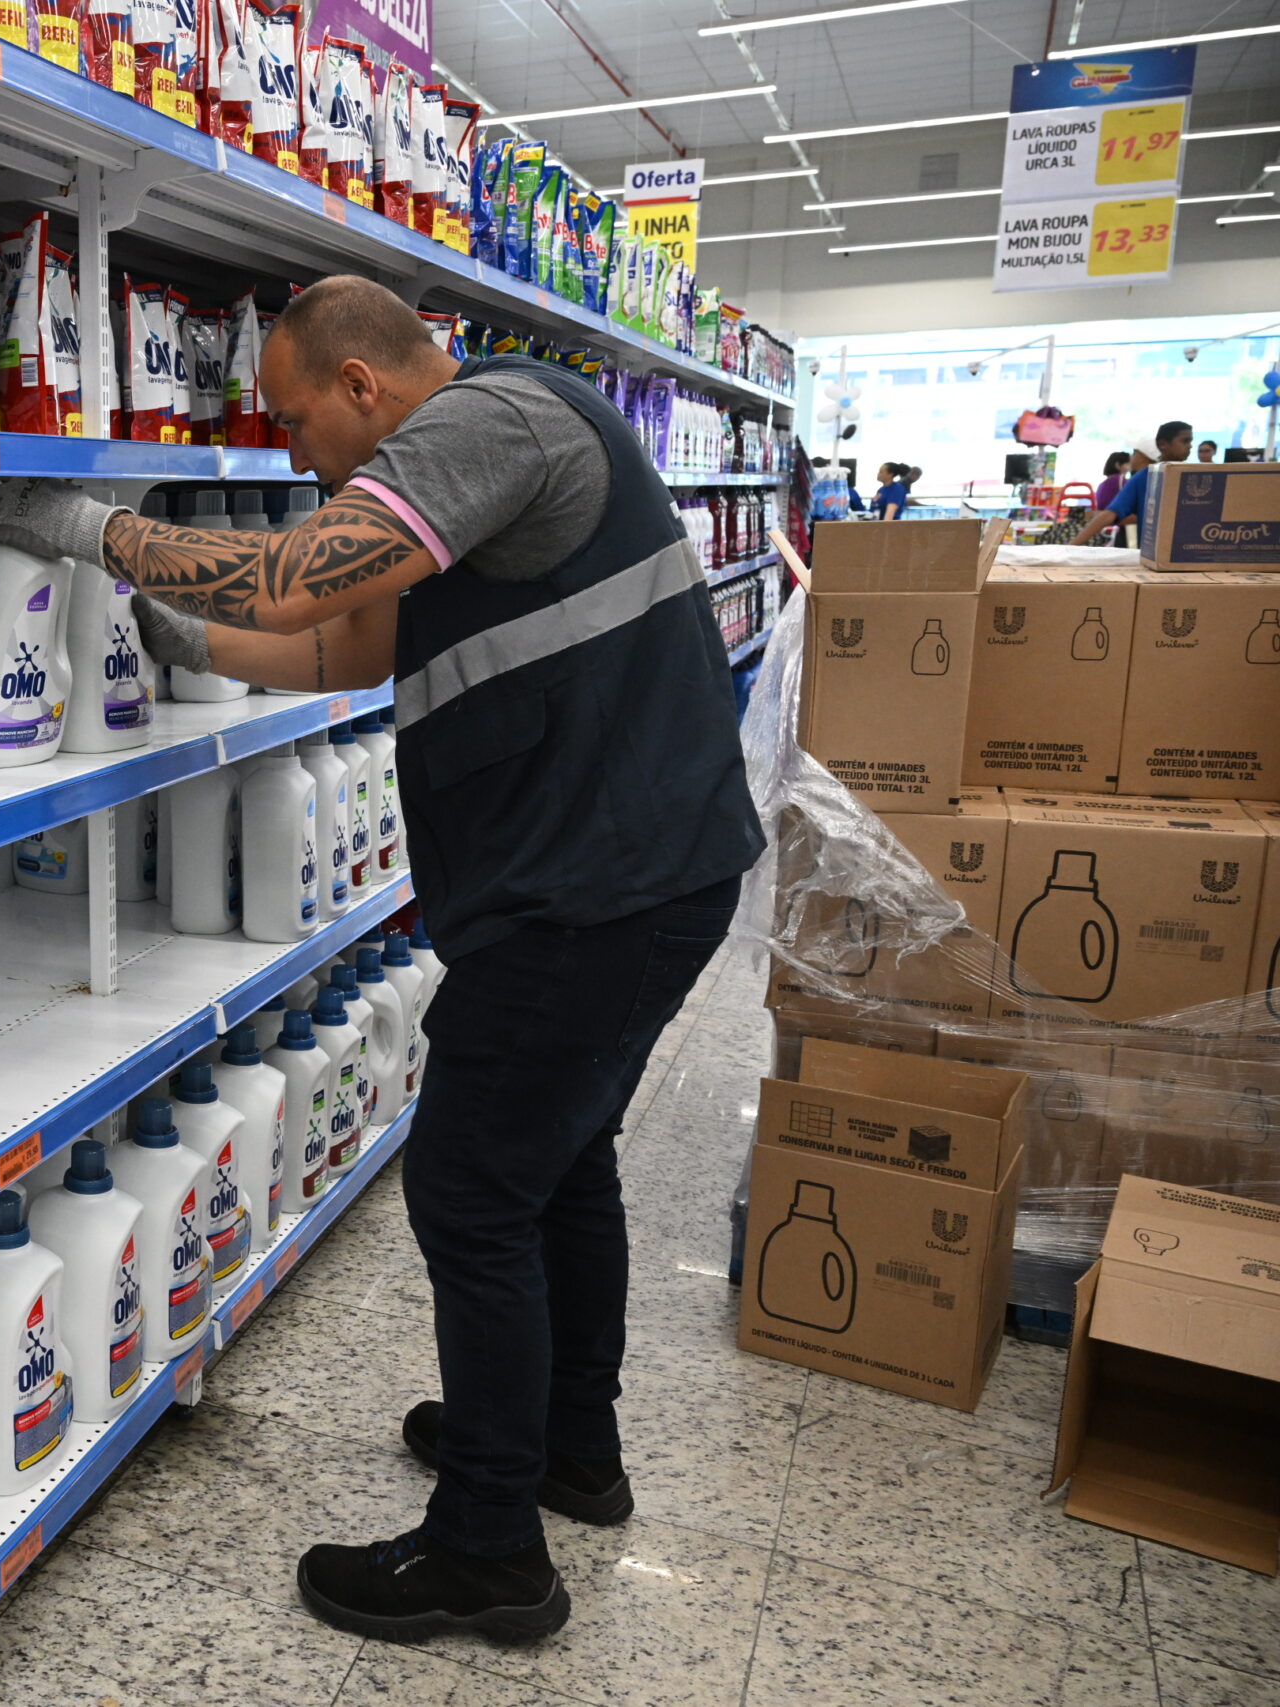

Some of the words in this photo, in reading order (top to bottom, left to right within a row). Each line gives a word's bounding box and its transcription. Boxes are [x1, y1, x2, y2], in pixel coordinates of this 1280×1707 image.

[41, 25, 77, 46] REFIL
[1012, 126, 1043, 141] LAVA
[1046, 121, 1096, 137] ROUPAS
[1027, 139, 1077, 155] LÍQUIDO
[1102, 130, 1180, 162] 11,97
[1025, 154, 1059, 171] URCA
[1061, 153, 1075, 168] 3L
[632, 169, 696, 189] Oferta
[634, 215, 690, 237] LINHA
[1004, 218, 1038, 234] LAVA
[1041, 214, 1089, 230] ROUPA
[1008, 236, 1039, 250] MON
[1043, 232, 1082, 247] BIJOU
[1093, 223, 1169, 254] 13,33
[1001, 252, 1064, 269] MULTIAÇÃO
[1201, 523, 1271, 544] Comfort
[987, 636, 1029, 646] Unilever
[1155, 638, 1199, 649] Unilever
[826, 649, 867, 659] Unilever
[104, 652, 139, 680] OMO
[0, 670, 46, 699] OMO
[987, 740, 1026, 750] CONTÉM
[1028, 742, 1034, 750] 4
[1036, 743, 1084, 753] UNIDADES
[1153, 747, 1195, 757] CONTÉM
[1198, 749, 1204, 757] 4
[1207, 750, 1258, 760] UNIDADES
[980, 750, 1028, 760] CONTEÚDO
[1031, 752, 1075, 762] UNITÁRIO
[1078, 754, 1088, 762] 3L
[1146, 757, 1198, 768] CONTEÚDO
[1201, 760, 1248, 770] UNITÁRIO
[1251, 762, 1264, 771] 3L
[827, 759, 866, 769] CONTÉM
[869, 761, 875, 770] 4
[877, 762, 926, 773] UNIDADES
[984, 759, 1032, 770] CONTEÚDO
[1035, 762, 1062, 772] TOTAL
[1066, 764, 1083, 772] 12L
[1150, 767, 1202, 778] CONTEÚDO
[1205, 770, 1234, 780] TOTAL
[1239, 772, 1257, 781] 12L
[872, 772, 917, 783] UNITÁRIO
[919, 775, 931, 784] 3L
[876, 783, 904, 793] TOTAL
[908, 785, 925, 794] 12L
[380, 815, 397, 836] OMO
[943, 873, 988, 884] Unilever
[1192, 894, 1241, 905] Unilever
[953, 1003, 973, 1013] CADA
[331, 1109, 355, 1134] OMO
[305, 1137, 326, 1163] OMO
[778, 1134, 835, 1153] CONSERVAR
[837, 1145, 852, 1157] EM
[854, 1148, 887, 1164] LUGAR
[889, 1156, 916, 1170] SECO
[918, 1162, 924, 1171] E
[927, 1164, 967, 1180] FRESCO
[210, 1186, 238, 1219] OMO
[173, 1235, 202, 1271] OMO
[925, 1239, 971, 1256] Unilever
[752, 1328, 796, 1347] DETERGENTE
[796, 1340, 827, 1354] LÍQUIDO
[832, 1350, 863, 1364] CONTÉM
[864, 1357, 870, 1366] 4
[870, 1358, 908, 1377] UNIDADES
[909, 1370, 920, 1380] DE
[920, 1372, 926, 1381] 3
[927, 1374, 932, 1383] L
[933, 1376, 955, 1389] CADA
[18, 1348, 55, 1393] OMO
